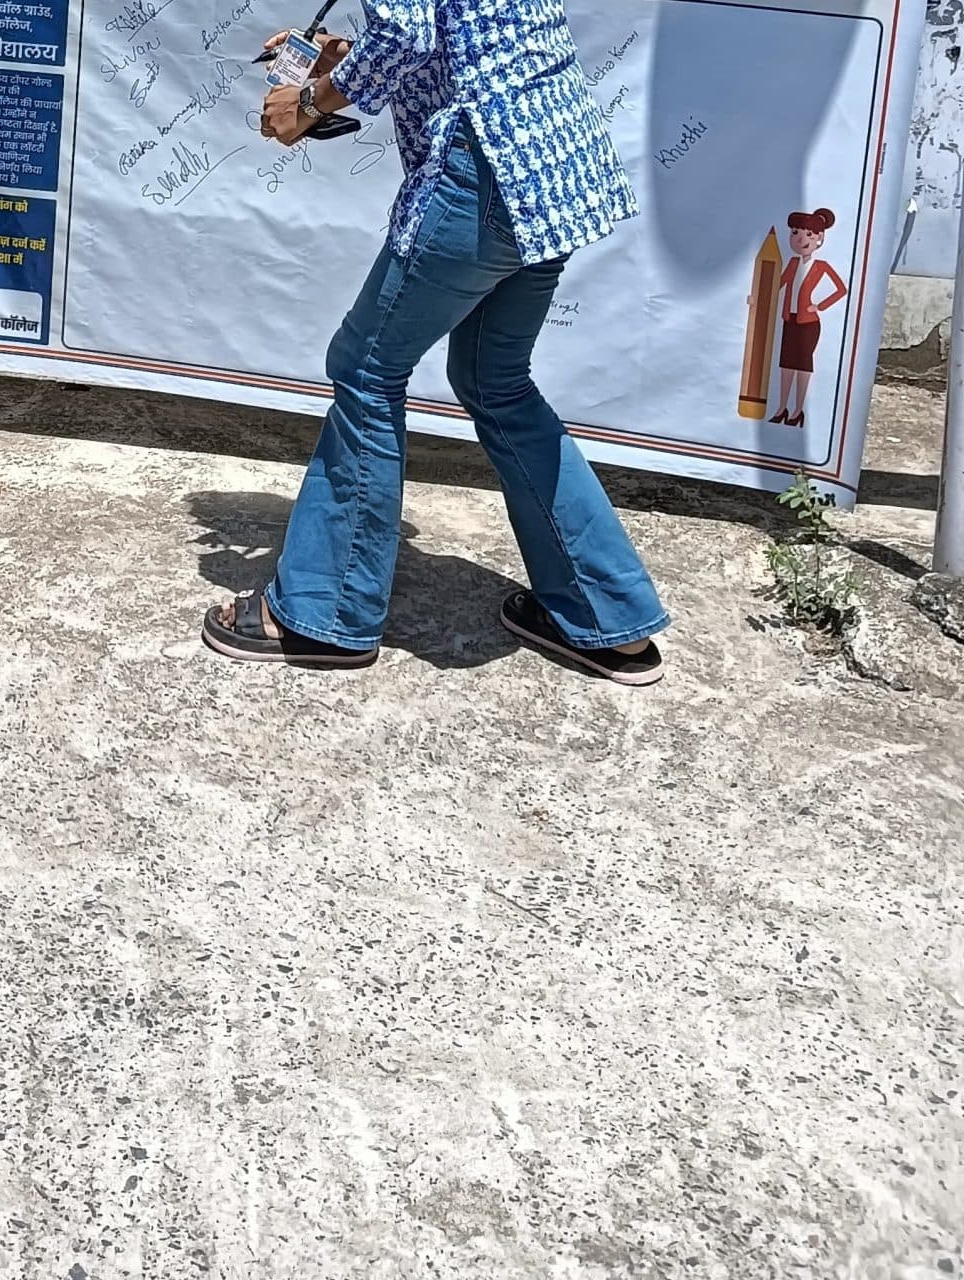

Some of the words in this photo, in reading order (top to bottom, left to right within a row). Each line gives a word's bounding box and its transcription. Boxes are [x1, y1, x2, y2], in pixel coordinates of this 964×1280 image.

[8, 85, 20, 95] की
[20, 97, 32, 108] की
[36, 132, 47, 142] भी
[654, 116, 708, 169] Khushi
[3, 141, 18, 150] एक
[22, 163, 43, 174] लिया
[15, 199, 28, 212] को
[12, 237, 29, 249] दर्ज
[12, 252, 23, 264] में
[0, 314, 39, 333] कॉलेज
